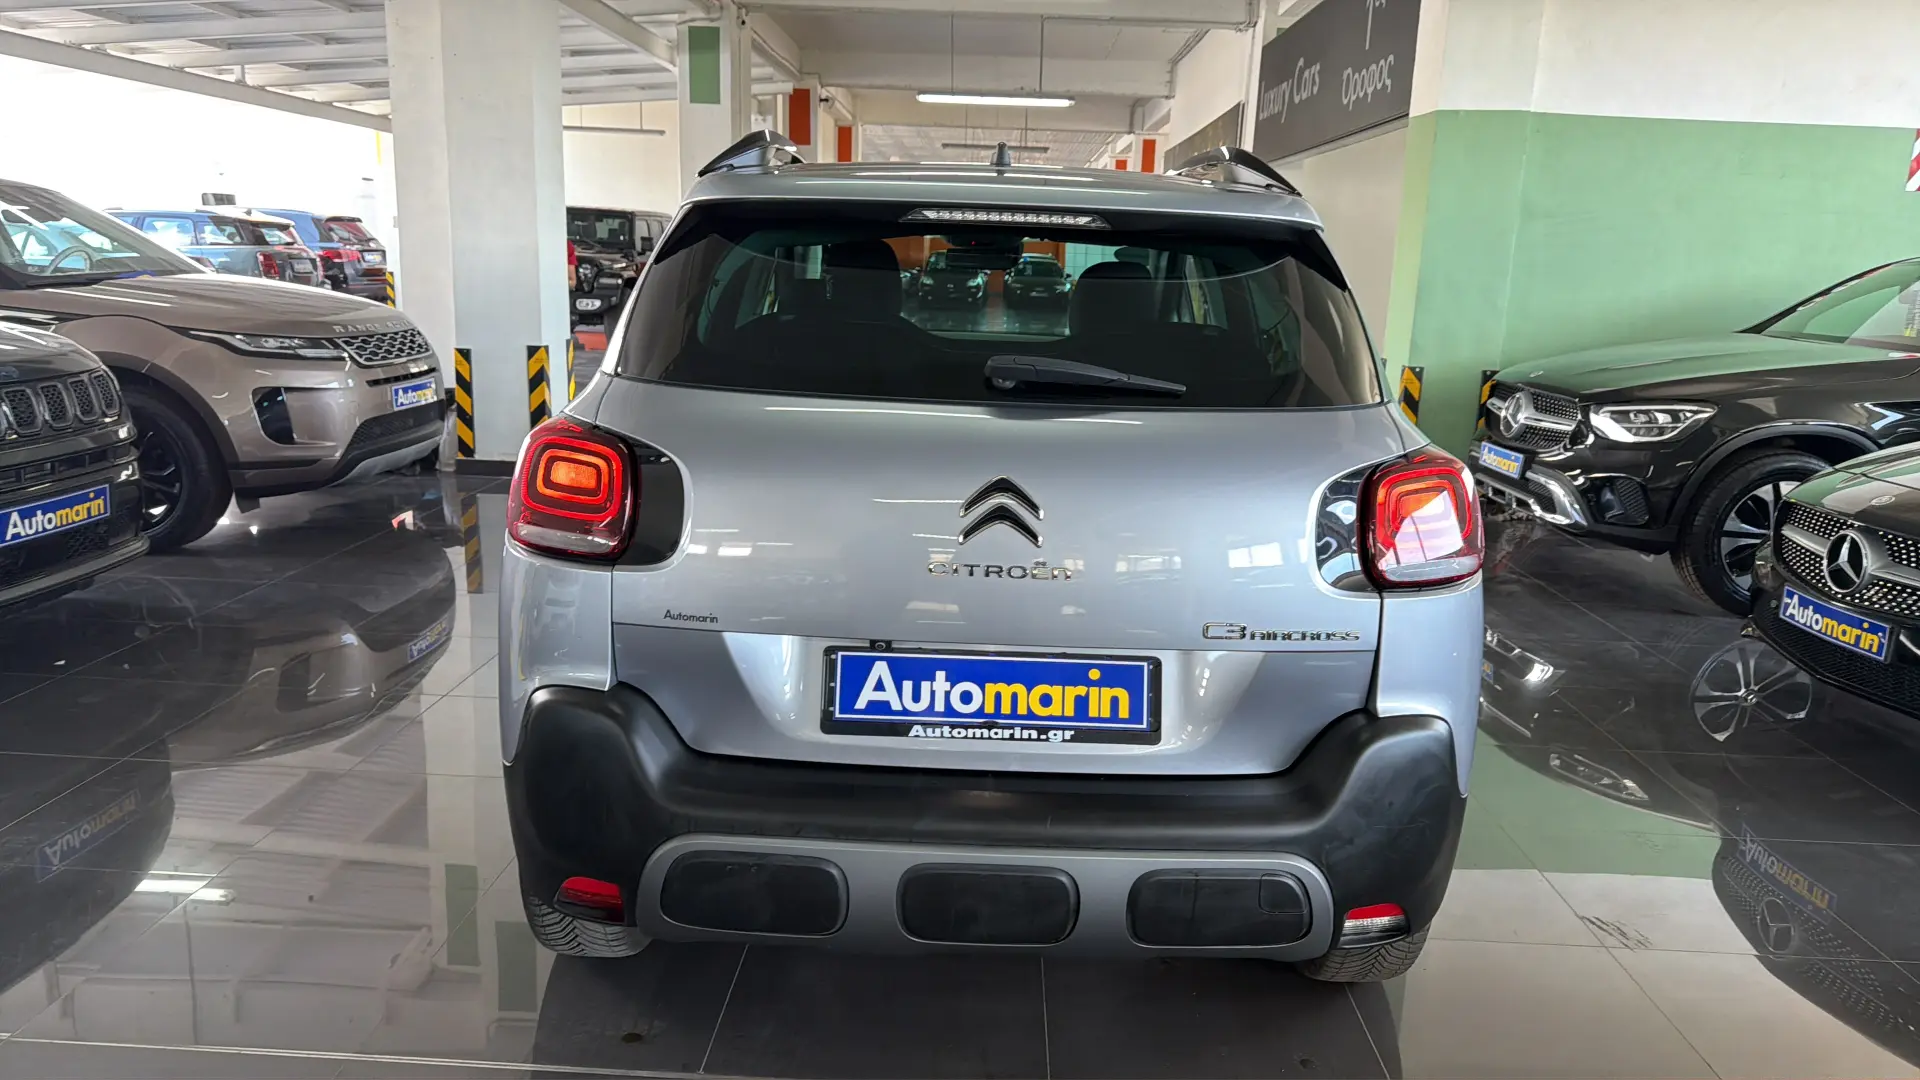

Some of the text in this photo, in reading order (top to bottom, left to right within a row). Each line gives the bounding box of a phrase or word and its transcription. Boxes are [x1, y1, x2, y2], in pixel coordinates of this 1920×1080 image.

[1259, 57, 1321, 124] Luxury Cars
[5, 492, 105, 541] Automarin
[663, 609, 718, 623] Automarin
[1202, 622, 1360, 641] C3 AIRCROSS
[1785, 594, 1880, 653] Automarin
[854, 660, 1130, 719] Automarin
[908, 724, 1075, 742] Automarin.gr
